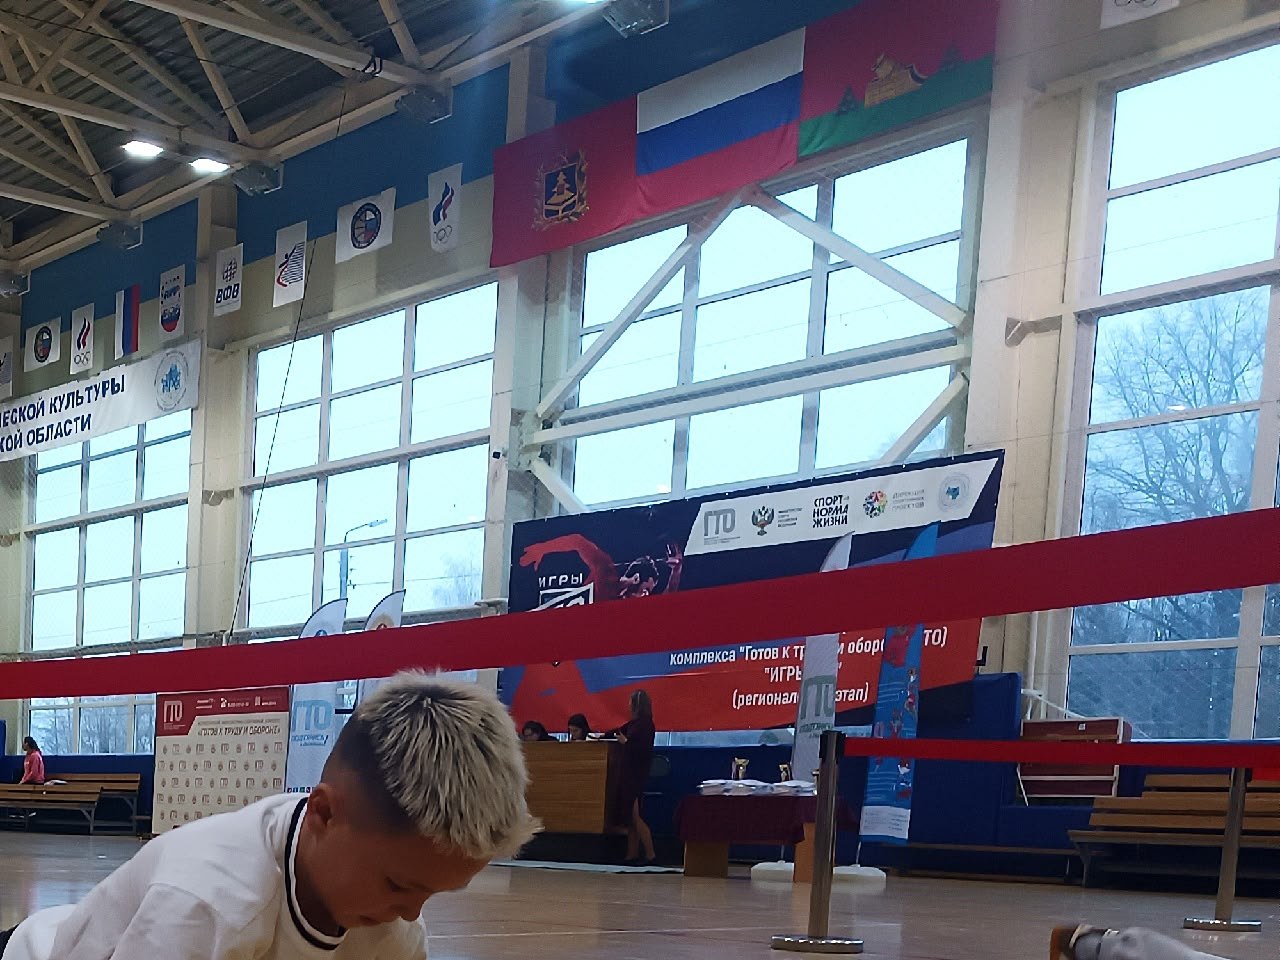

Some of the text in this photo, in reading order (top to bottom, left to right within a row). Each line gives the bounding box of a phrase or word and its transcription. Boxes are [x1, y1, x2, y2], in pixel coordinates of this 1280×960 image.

[216, 283, 240, 303] ВФВ
[49, 374, 125, 414] КУЛЬТУРЫ
[26, 413, 92, 446] ОБЛАСТИ
[814, 494, 843, 507] СПОРТ
[812, 504, 849, 518] НОРМА
[703, 508, 736, 536] ГТО
[812, 515, 848, 528] ЖИЗНИ
[539, 573, 583, 588] ИГРЫ
[670, 649, 736, 665] комплекса
[739, 645, 779, 661] "Готов
[782, 646, 790, 658] к
[732, 682, 869, 709] (регионал этап)
